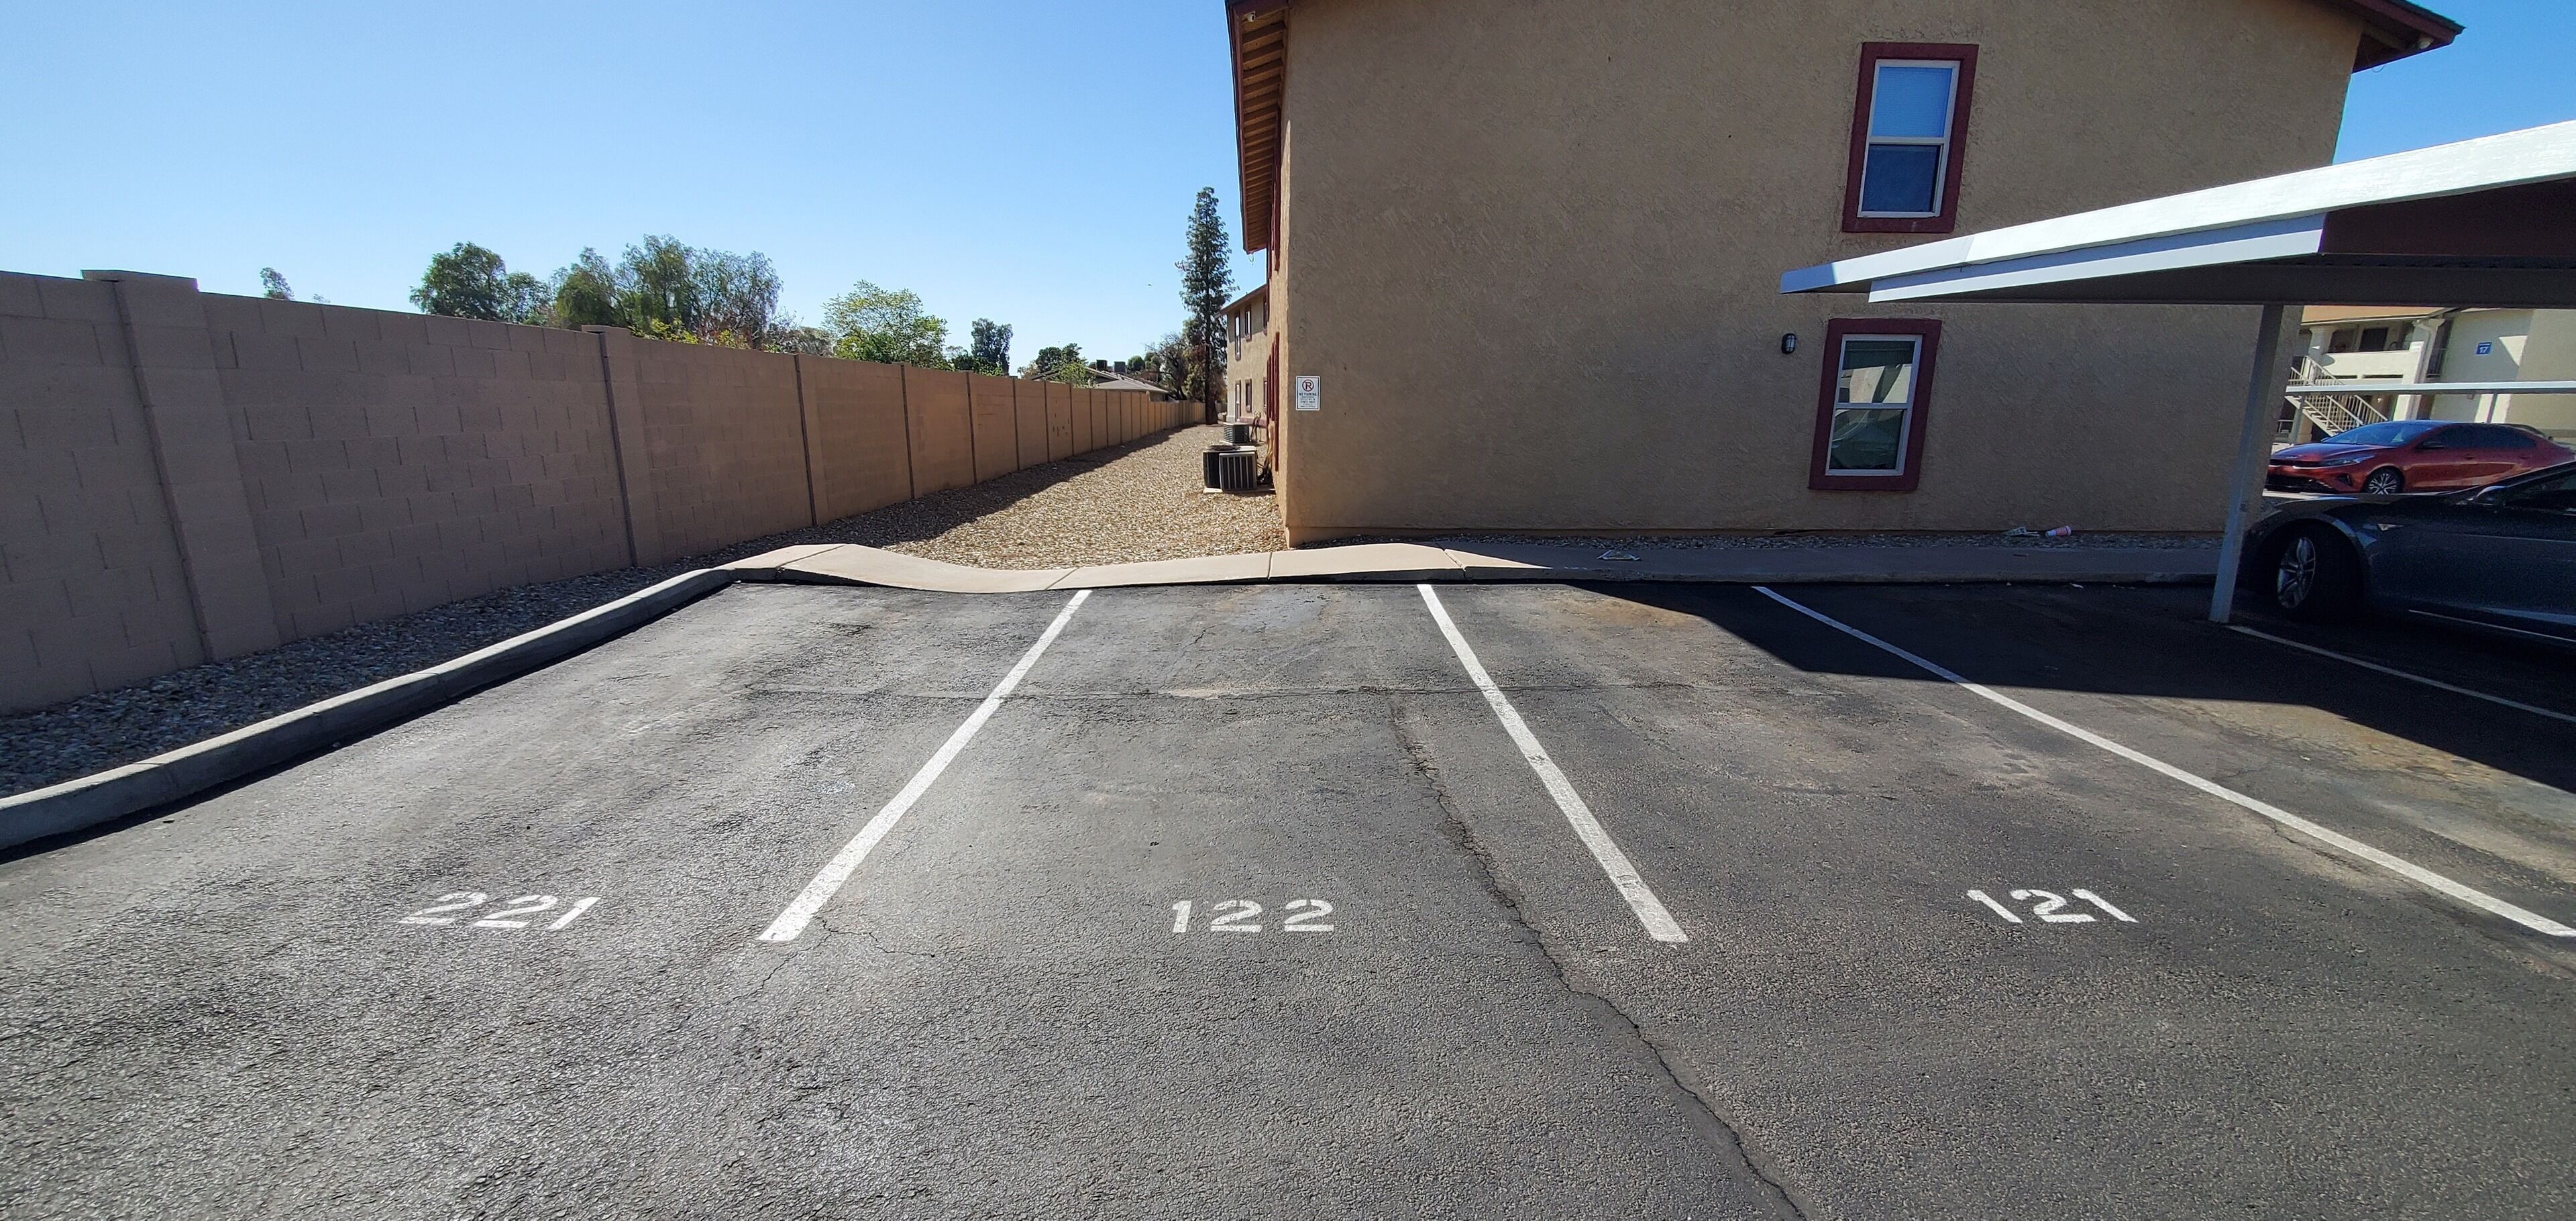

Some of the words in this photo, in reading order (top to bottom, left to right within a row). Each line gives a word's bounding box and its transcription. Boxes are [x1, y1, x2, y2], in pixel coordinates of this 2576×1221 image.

[399, 892, 602, 931] 221
[1173, 900, 1334, 933] 122
[1967, 888, 2139, 923] 121
